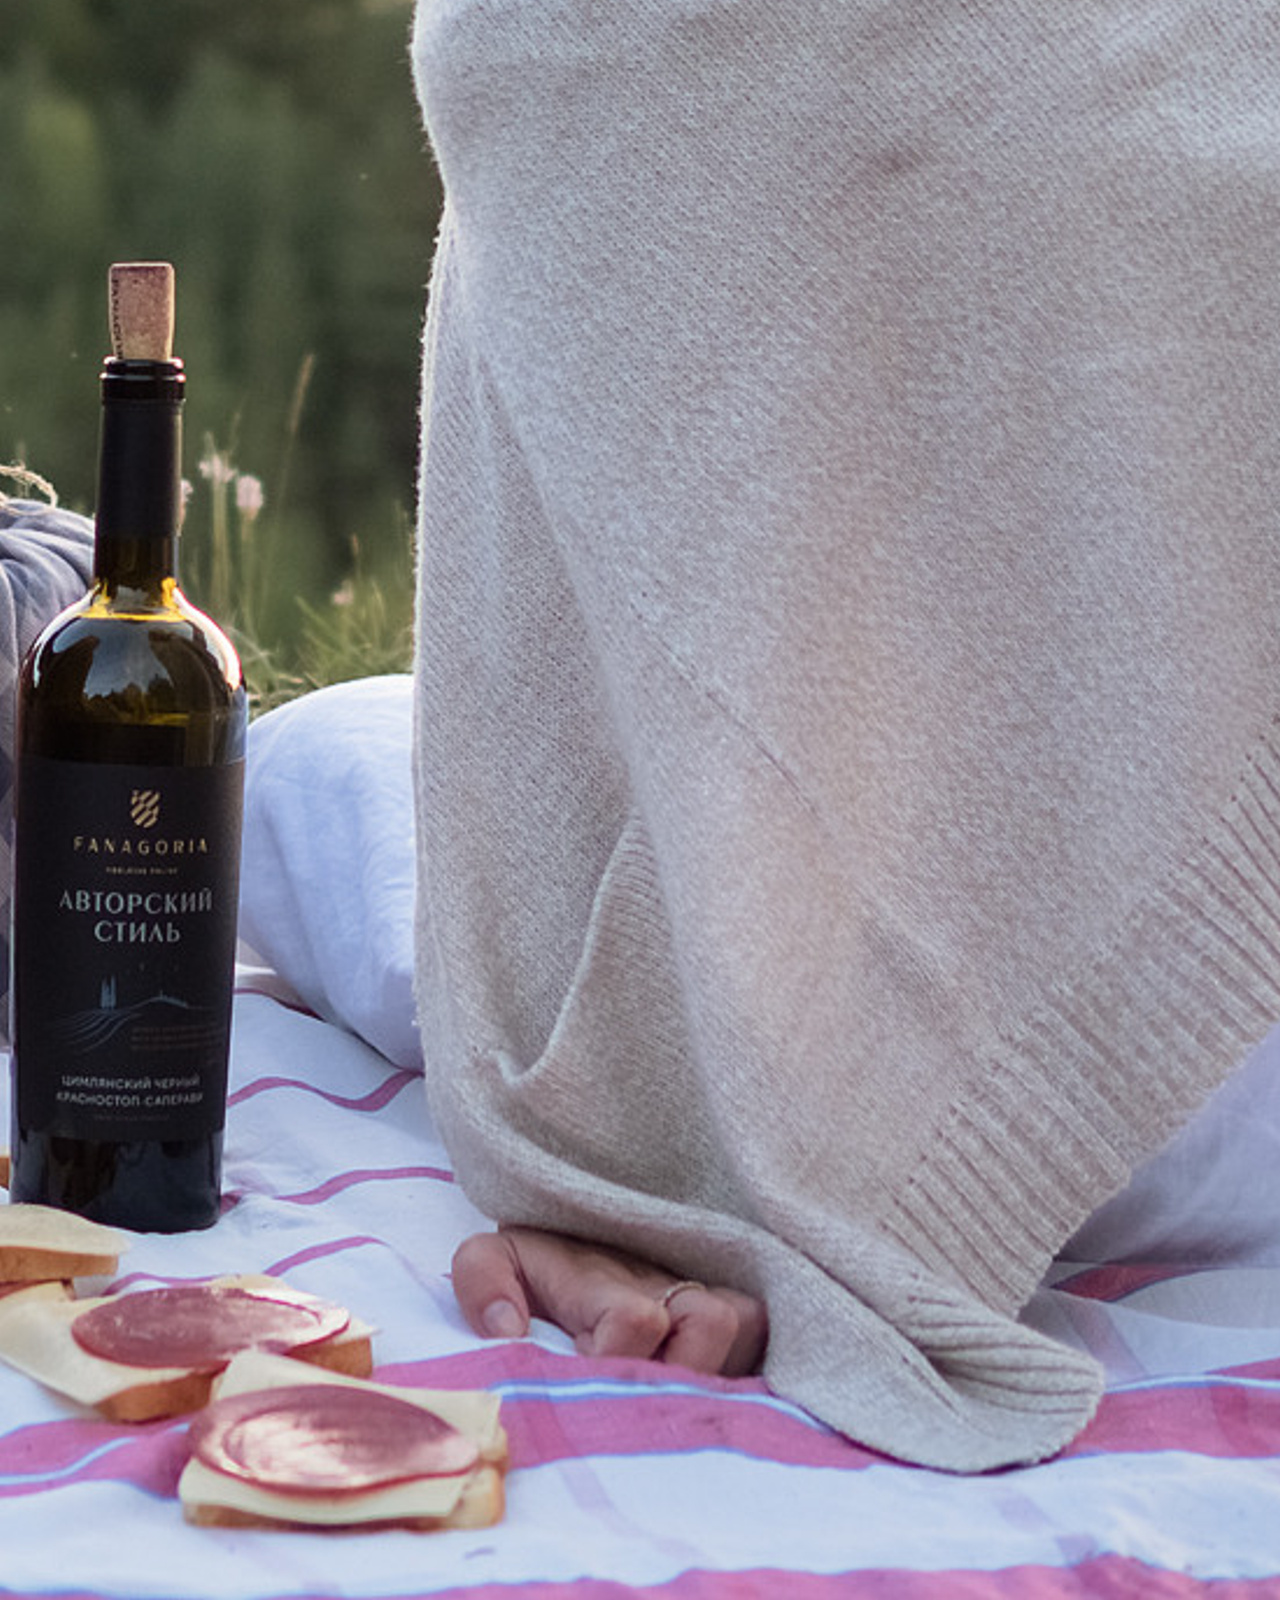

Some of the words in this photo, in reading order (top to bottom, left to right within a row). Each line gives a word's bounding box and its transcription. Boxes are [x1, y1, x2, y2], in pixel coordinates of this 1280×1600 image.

[73, 836, 208, 855] FANAGORIA
[59, 888, 213, 914] АВТОРСКИЙ
[94, 920, 181, 943] СТИЛЬ
[61, 1076, 152, 1090] ЦИМЛЯНСКИЙ
